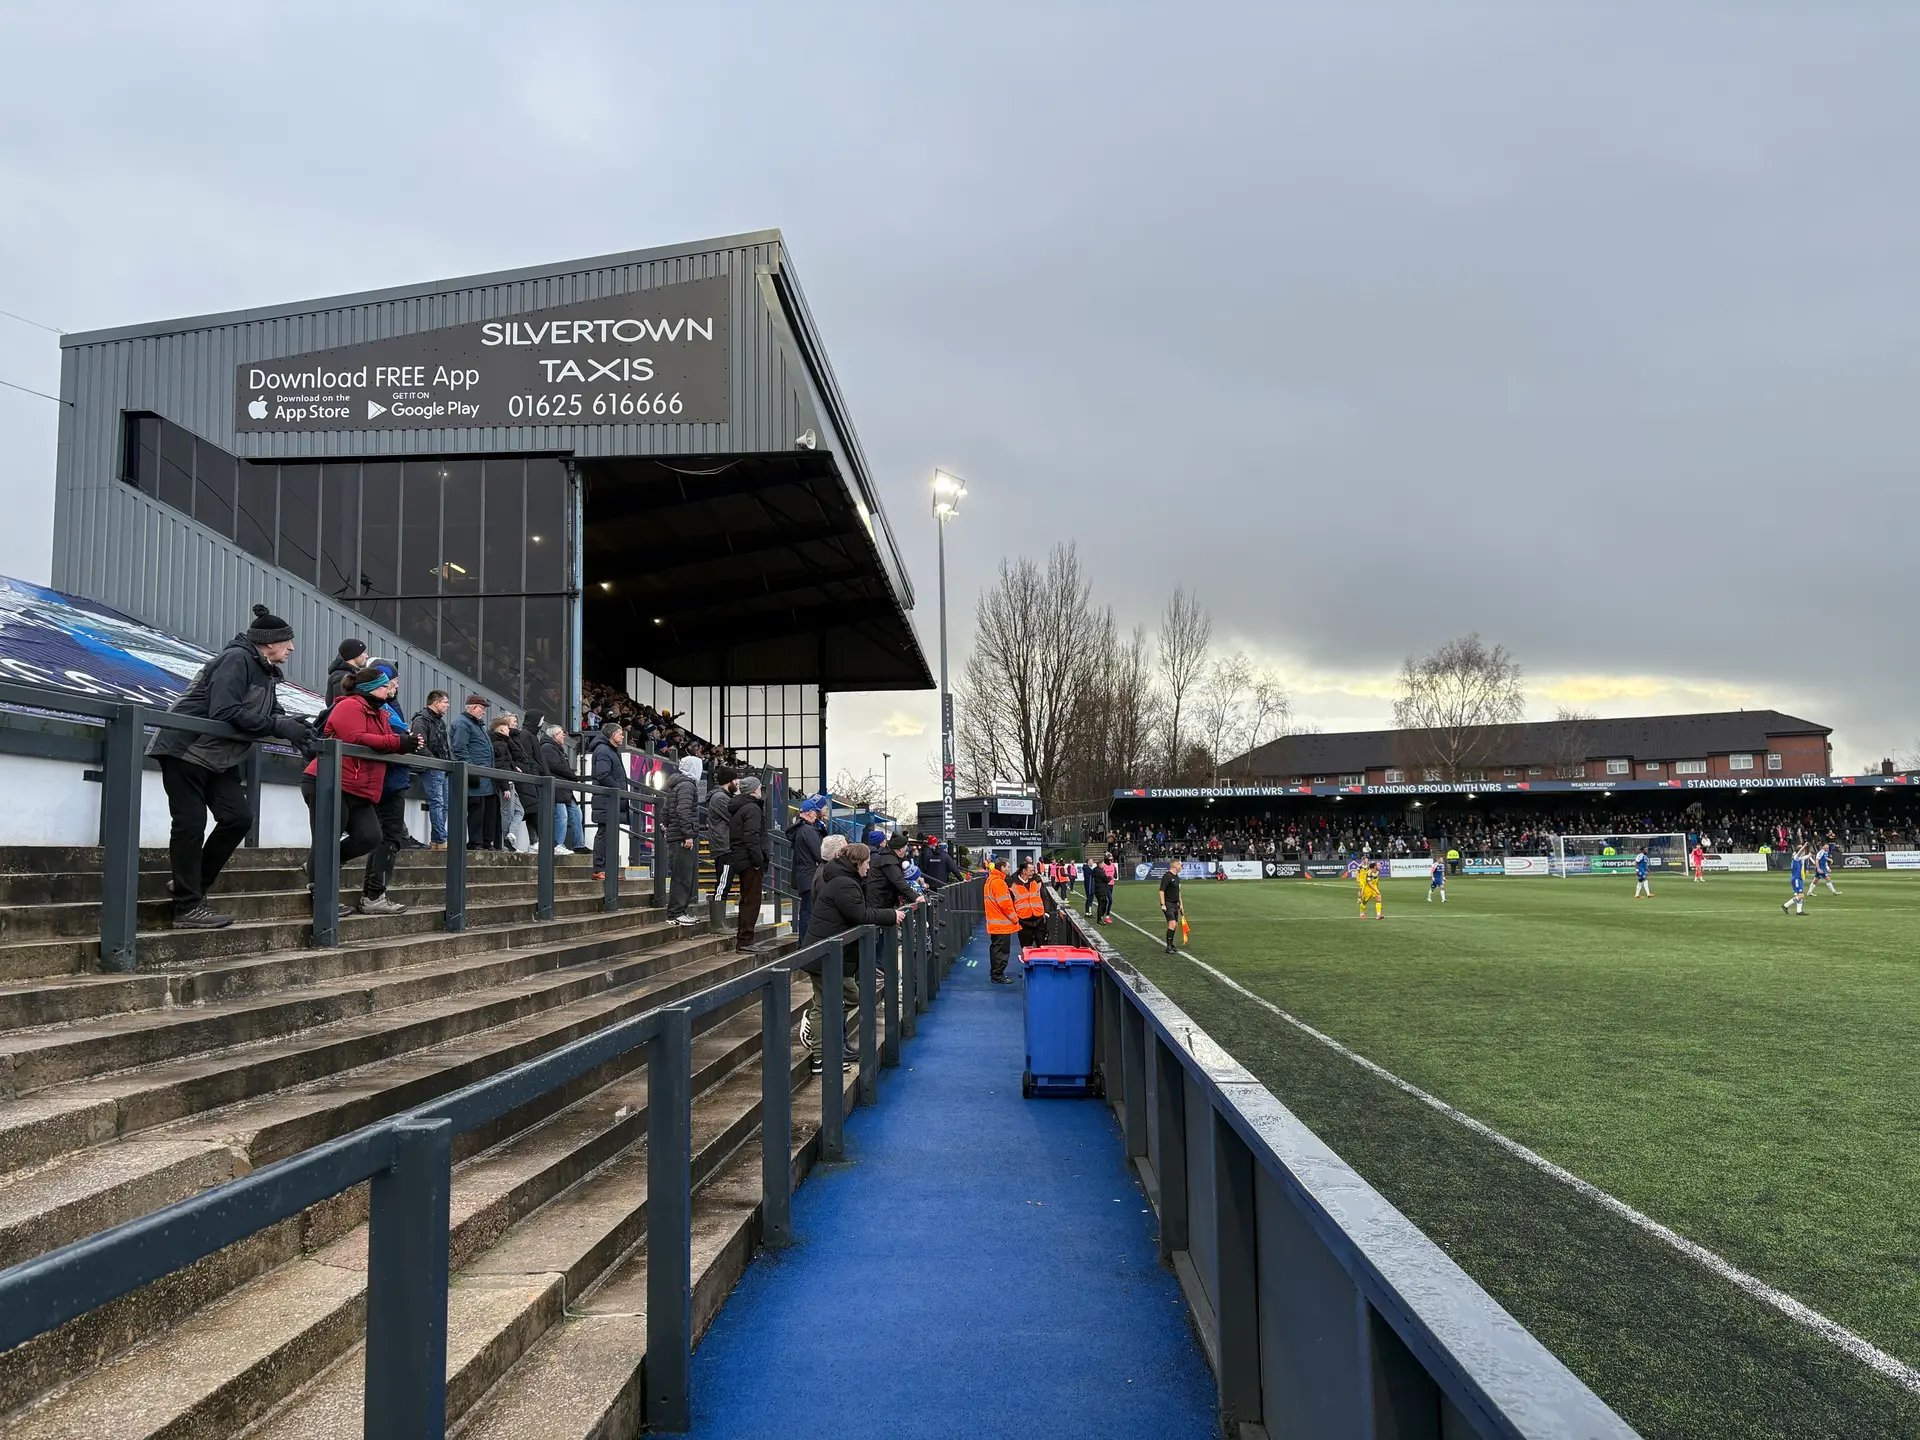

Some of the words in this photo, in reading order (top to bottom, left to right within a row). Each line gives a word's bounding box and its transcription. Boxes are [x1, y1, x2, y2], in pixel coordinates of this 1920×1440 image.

[481, 317, 713, 346] SILVERTOWN
[249, 365, 367, 390] Download
[375, 366, 425, 388] FREE
[432, 365, 480, 392] App
[539, 357, 654, 383] TAXIS
[277, 395, 320, 403] Download
[336, 394, 350, 402] the
[393, 392, 407, 400] GET
[409, 392, 415, 400] IT
[416, 392, 430, 400] ON
[508, 393, 583, 418] 01625
[592, 391, 684, 417] 616666
[275, 404, 306, 423] App
[309, 404, 350, 419] Store
[391, 402, 445, 419] Google
[447, 401, 480, 418] Play
[1367, 785, 1417, 795] STANDING
[1418, 784, 1451, 793] PROUD
[1453, 783, 1478, 793] WITH
[1479, 783, 1502, 792] WRS
[1687, 779, 1738, 788] STANDING
[1739, 778, 1774, 787] PROUD
[1775, 777, 1801, 787] WITH
[1803, 777, 1826, 786] WRS
[1151, 789, 1199, 798] STANDING
[1201, 788, 1234, 797] PROUD
[1236, 787, 1260, 796] WITH
[1261, 786, 1284, 795] WRS
[944, 780, 956, 830] recruit
[1595, 859, 1637, 868] enterprise
